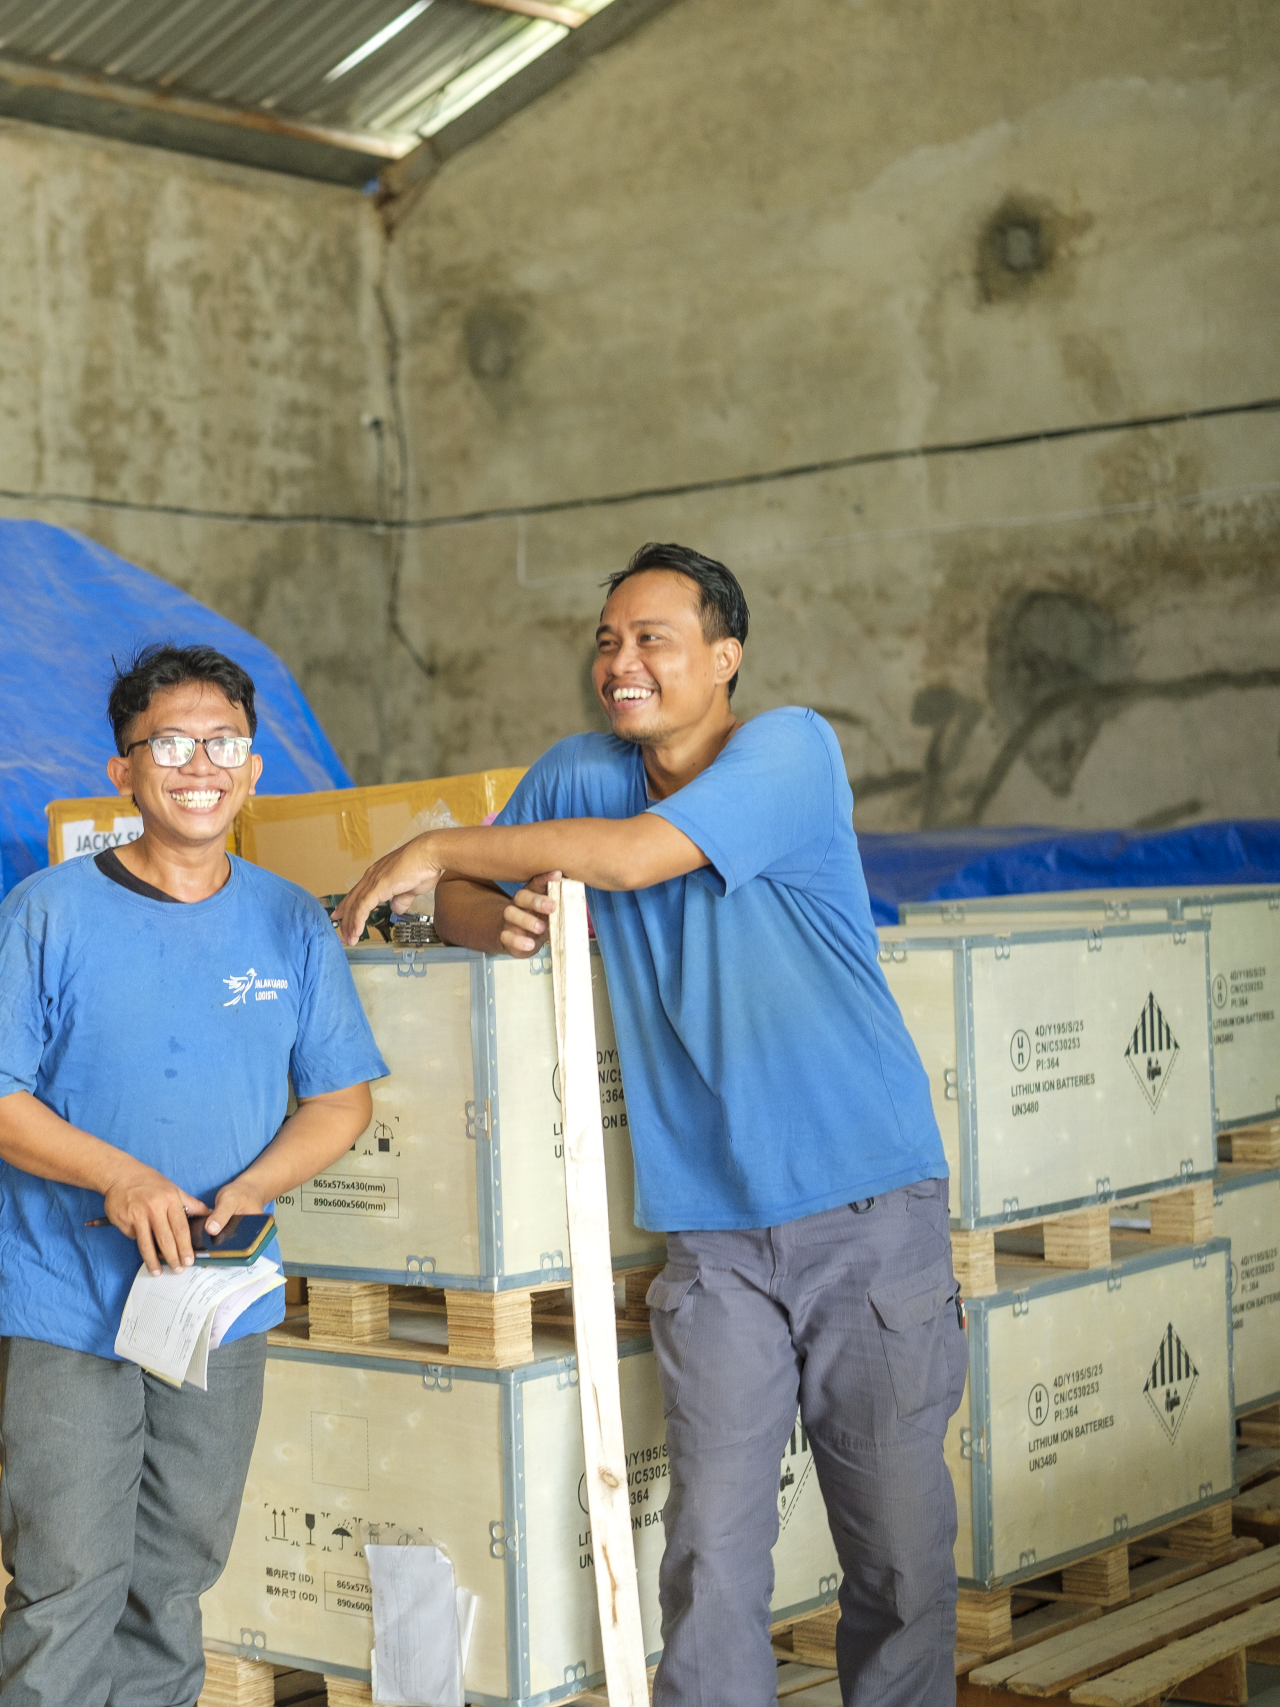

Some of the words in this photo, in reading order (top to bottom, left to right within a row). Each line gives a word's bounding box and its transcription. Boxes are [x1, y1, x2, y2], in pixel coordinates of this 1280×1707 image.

[76, 832, 122, 852] JACKY
[1034, 1019, 1084, 1037] 4D/Y195/S/25
[1035, 1037, 1081, 1054] CN/C530253
[1036, 1057, 1060, 1071] PI:364
[1011, 1081, 1041, 1097] LITHIUM
[1042, 1080, 1055, 1092] ION
[1056, 1073, 1095, 1090] BATTERIES
[1011, 1100, 1039, 1117] UN3480
[313, 1179, 386, 1193] 865x575x430(mm)
[275, 1195, 295, 1206] (OD)
[313, 1198, 386, 1212] 890x600x560(mm)
[1053, 1363, 1103, 1388] 4D/Y195/S/25
[1053, 1381, 1100, 1405] CN/C530253
[1054, 1404, 1078, 1422] PI:364
[1028, 1432, 1059, 1453] LITHIUM
[1060, 1427, 1074, 1443] ION
[1075, 1415, 1114, 1439] BATTERIES
[1029, 1452, 1057, 1472] UN3480
[265, 1566, 296, 1582] 箱内尺寸
[298, 1573, 314, 1585] (ID)
[266, 1584, 297, 1600] 箱外尺寸
[298, 1591, 318, 1604] (OD)
